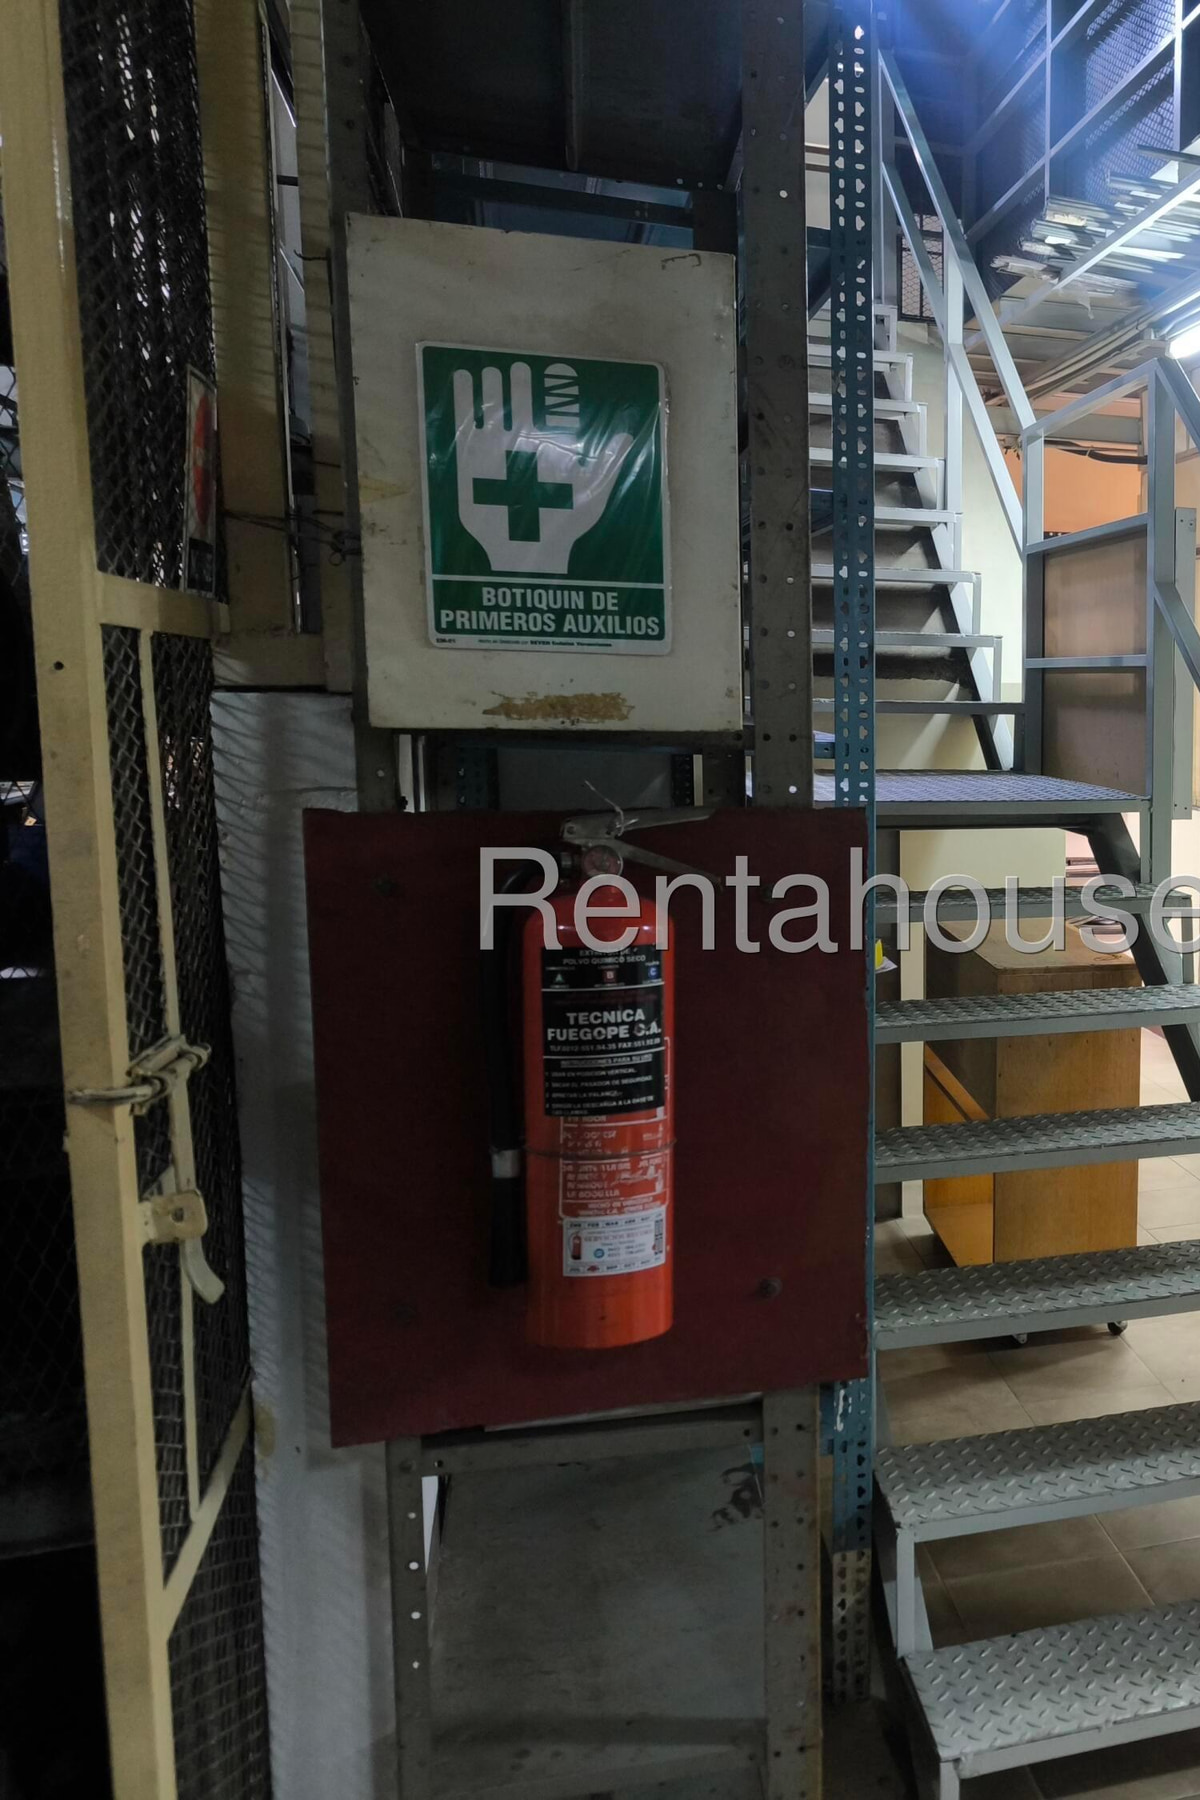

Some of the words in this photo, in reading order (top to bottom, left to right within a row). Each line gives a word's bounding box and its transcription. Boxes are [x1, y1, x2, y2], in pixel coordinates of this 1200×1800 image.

[482, 586, 585, 611] BOTIQUIN
[592, 591, 619, 612] DE
[440, 609, 556, 633] PRIMEROS
[563, 613, 660, 636] AUXILIOS
[626, 954, 646, 963] SECO
[566, 1008, 645, 1025] TECNICA
[547, 1025, 630, 1041] FUEGOPE
[633, 1021, 662, 1037] C.A.
